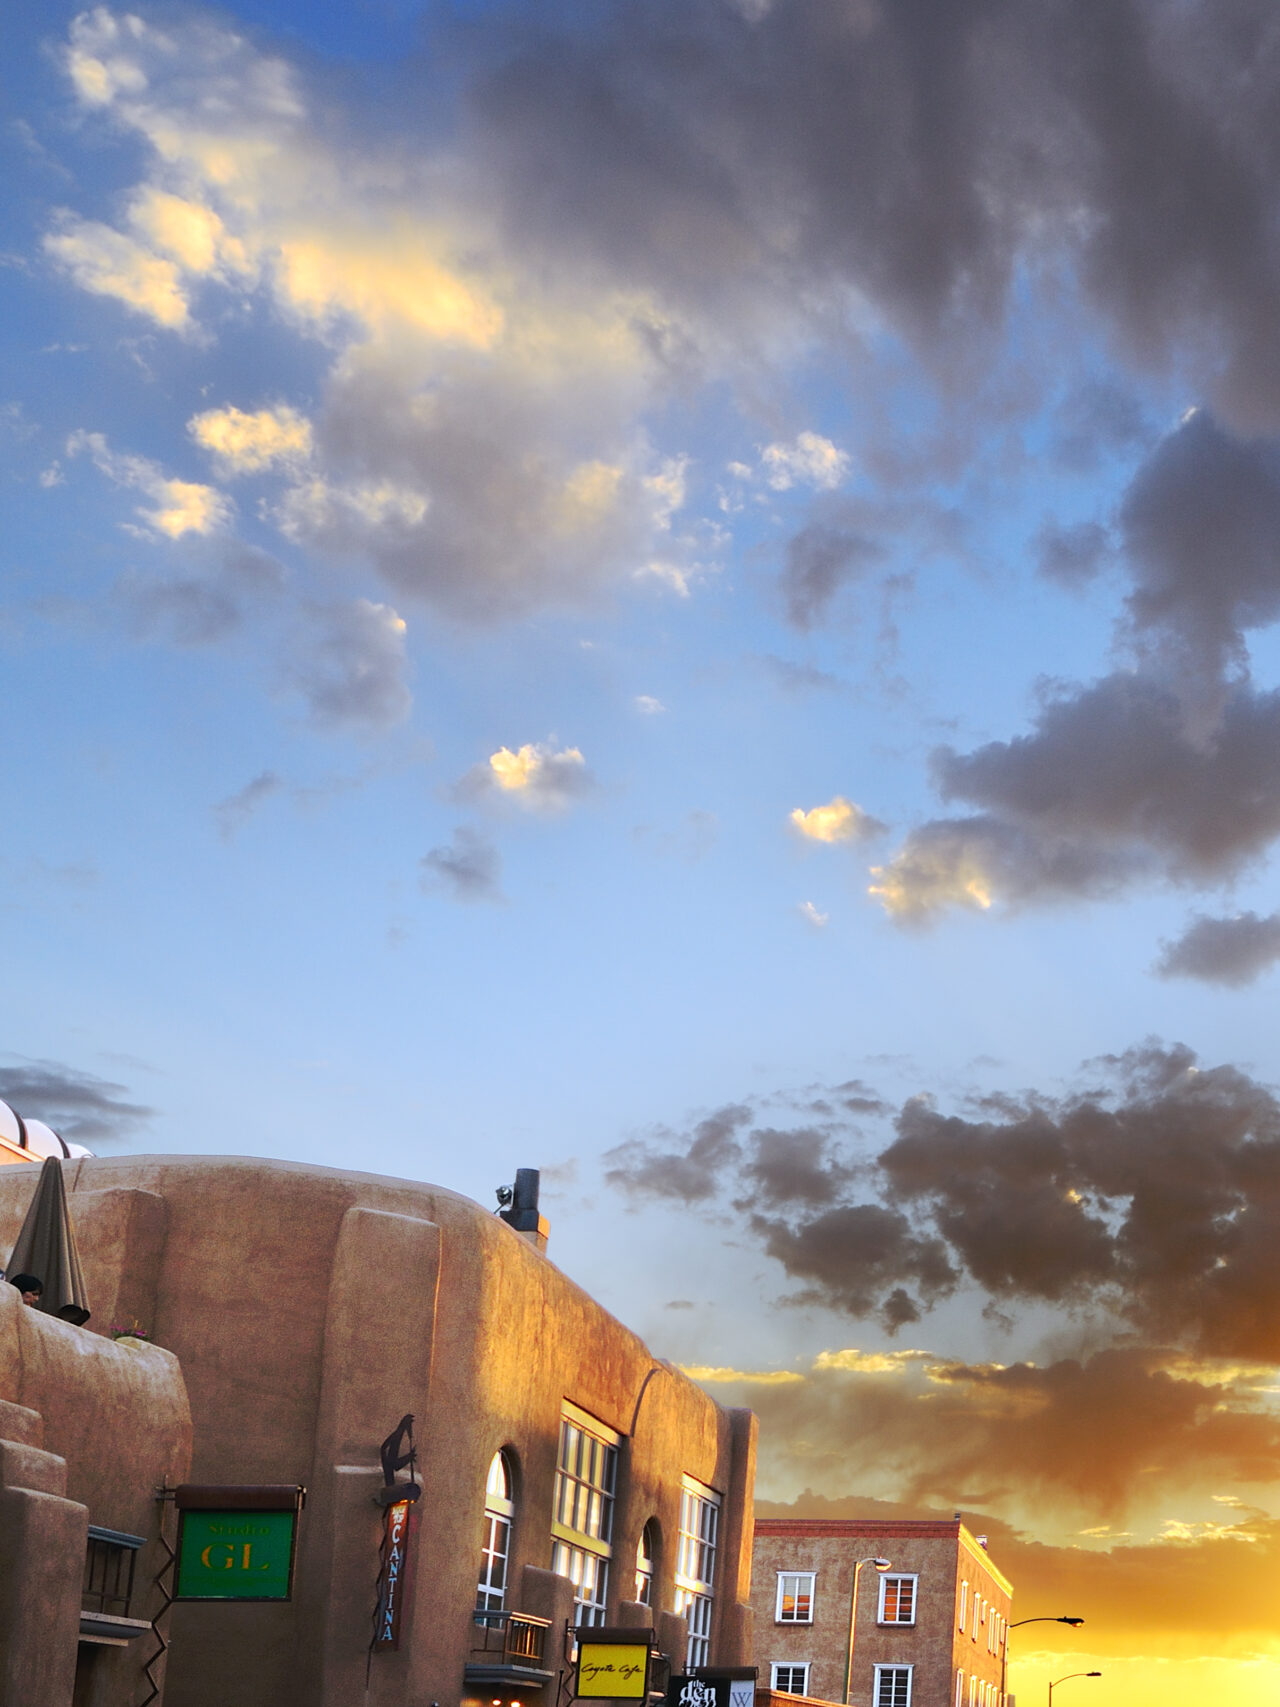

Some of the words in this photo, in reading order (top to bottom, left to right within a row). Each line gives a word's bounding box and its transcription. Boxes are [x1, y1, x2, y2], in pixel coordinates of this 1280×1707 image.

[208, 1522, 270, 1536] Studio
[201, 1542, 270, 1571] GL
[381, 1524, 402, 1641] CANTINA
[581, 1662, 616, 1682] Coyote
[679, 1679, 717, 1702] den
[693, 1679, 706, 1688] the
[731, 1691, 753, 1707] W
